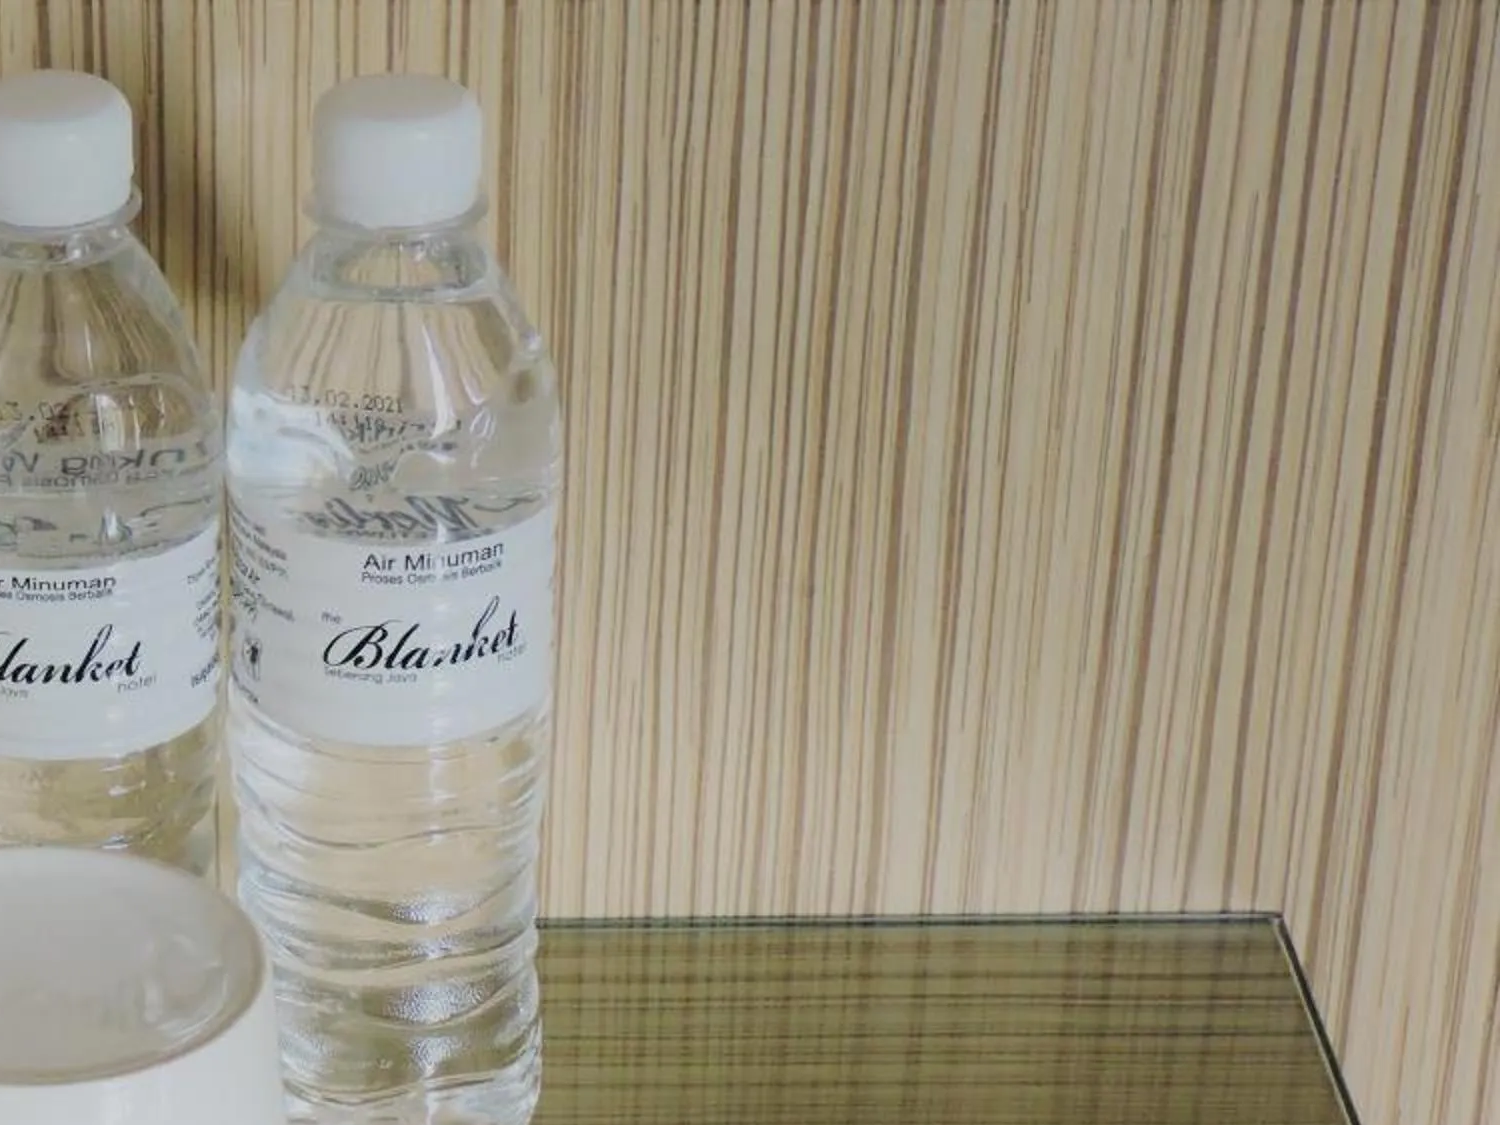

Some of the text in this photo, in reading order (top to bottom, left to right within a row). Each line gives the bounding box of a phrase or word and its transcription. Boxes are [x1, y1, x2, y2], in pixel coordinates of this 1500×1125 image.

[363, 552, 397, 572] Air
[11, 574, 118, 591] Minuman
[361, 571, 404, 586] Proses
[322, 595, 520, 671] Blanket
